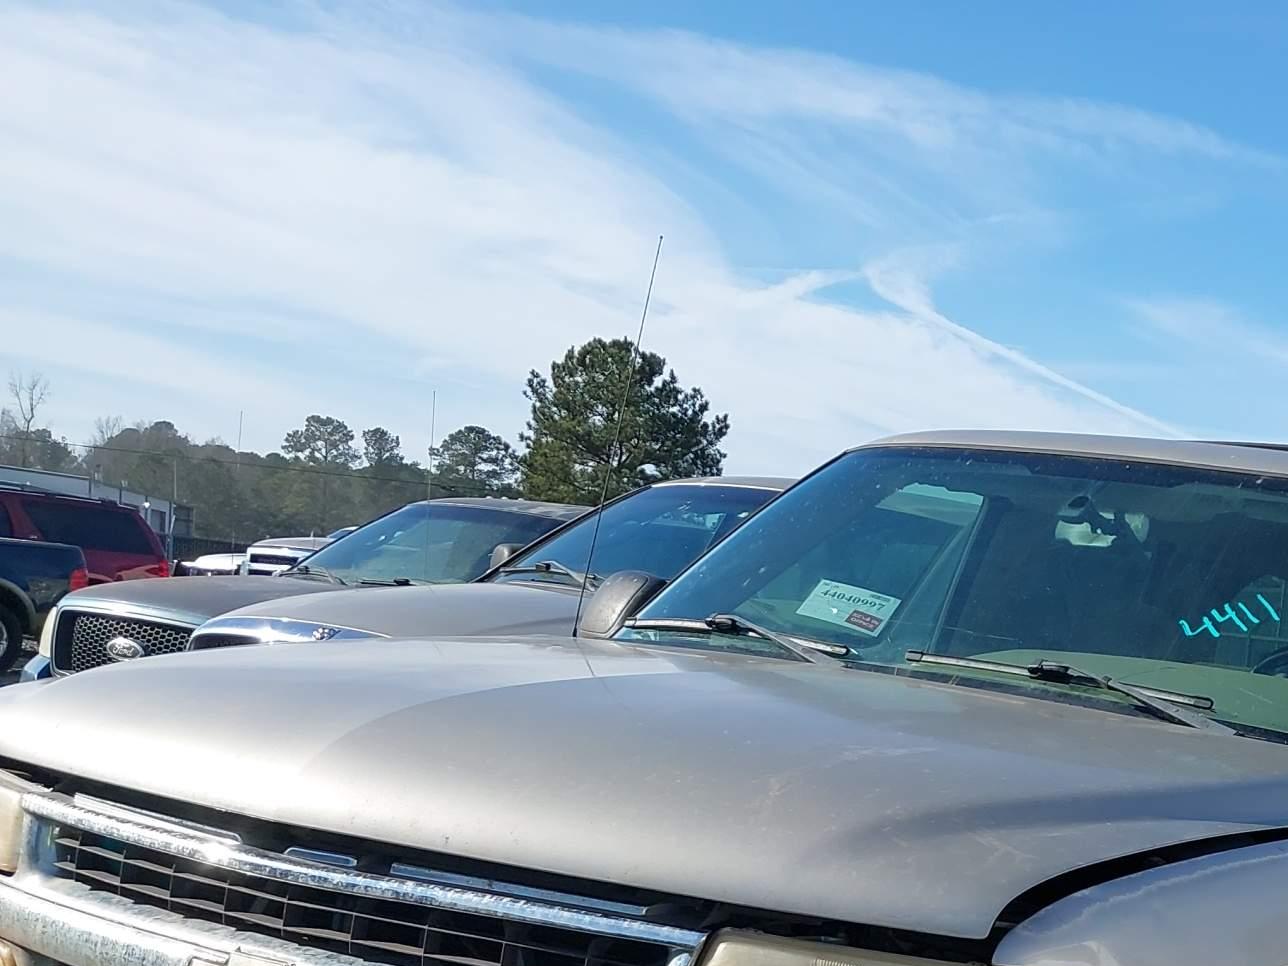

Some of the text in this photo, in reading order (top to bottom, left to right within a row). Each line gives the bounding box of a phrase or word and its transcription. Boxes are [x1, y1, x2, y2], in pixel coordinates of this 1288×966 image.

[820, 588, 886, 611] 44040997
[1178, 592, 1281, 638] 4411
[112, 642, 135, 657] Ford
